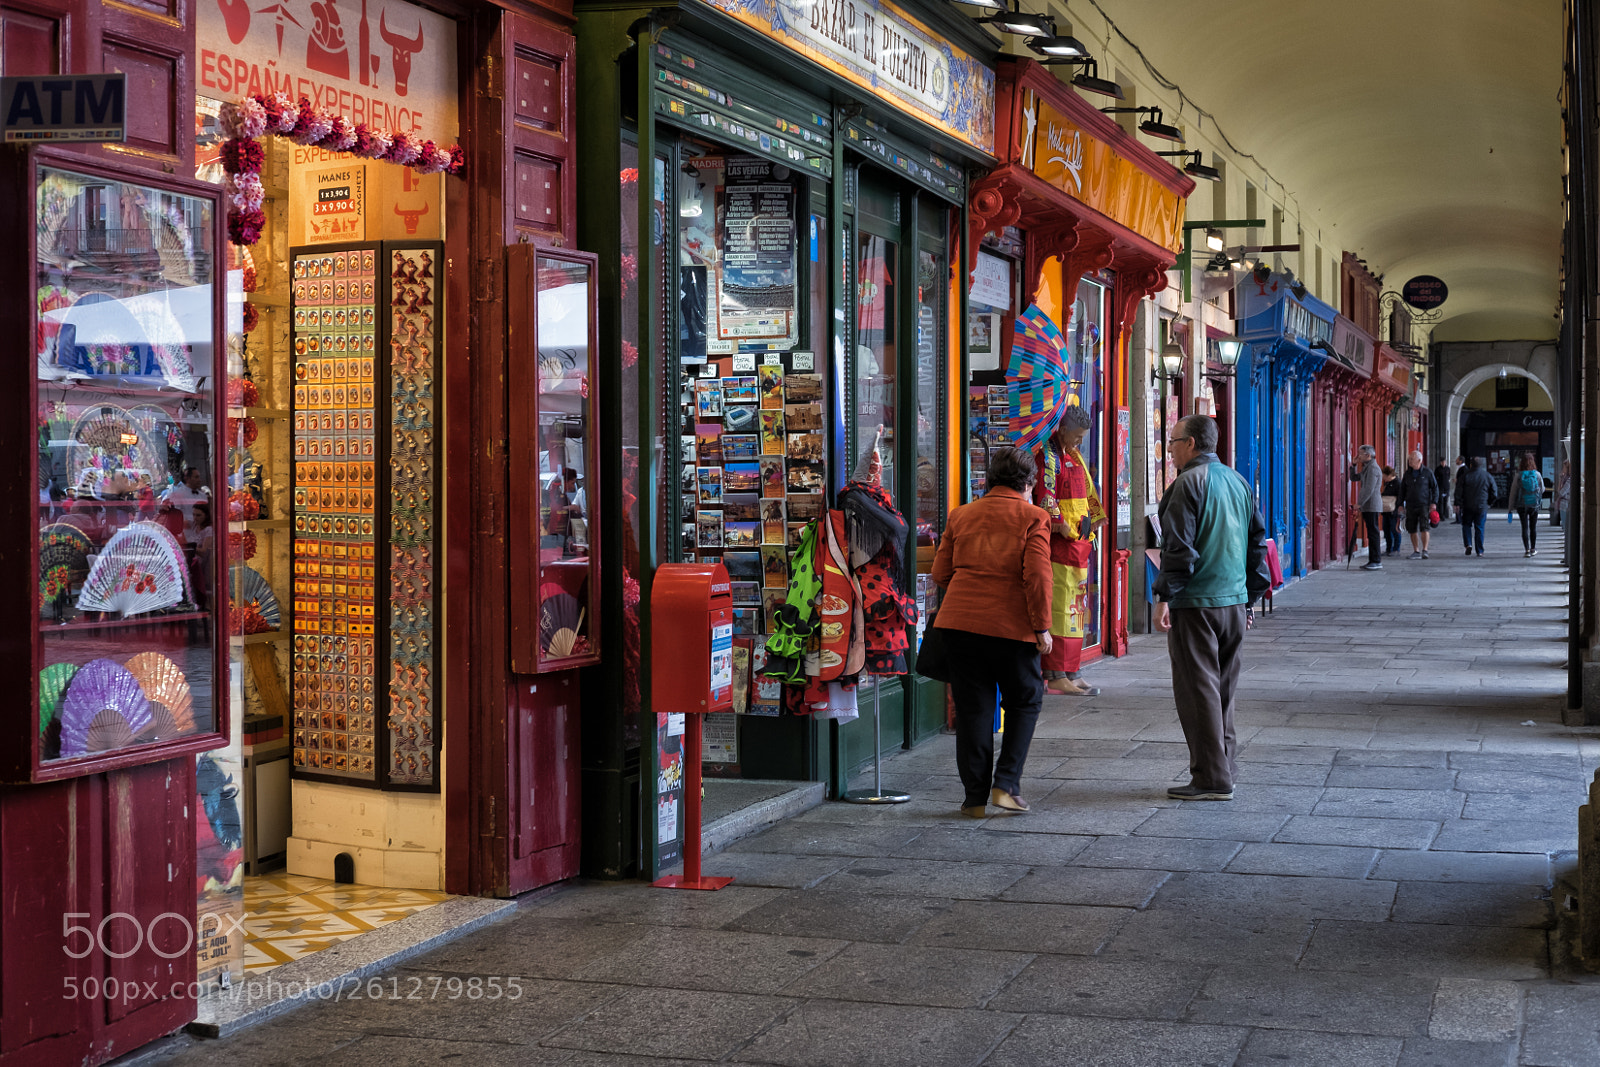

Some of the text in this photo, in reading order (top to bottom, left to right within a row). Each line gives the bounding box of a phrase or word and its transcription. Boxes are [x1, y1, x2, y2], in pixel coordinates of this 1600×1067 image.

[863, 12, 877, 65] EL
[6, 80, 123, 125] ATM
[728, 166, 770, 176] LAS VENTAS
[318, 172, 351, 183] IMANES
[330, 190, 343, 198] 3,90
[315, 204, 319, 213] 3
[329, 201, 347, 212] 9,90
[349, 201, 354, 209] €
[918, 305, 933, 386] MADRID
[1522, 415, 1553, 427] Casa
